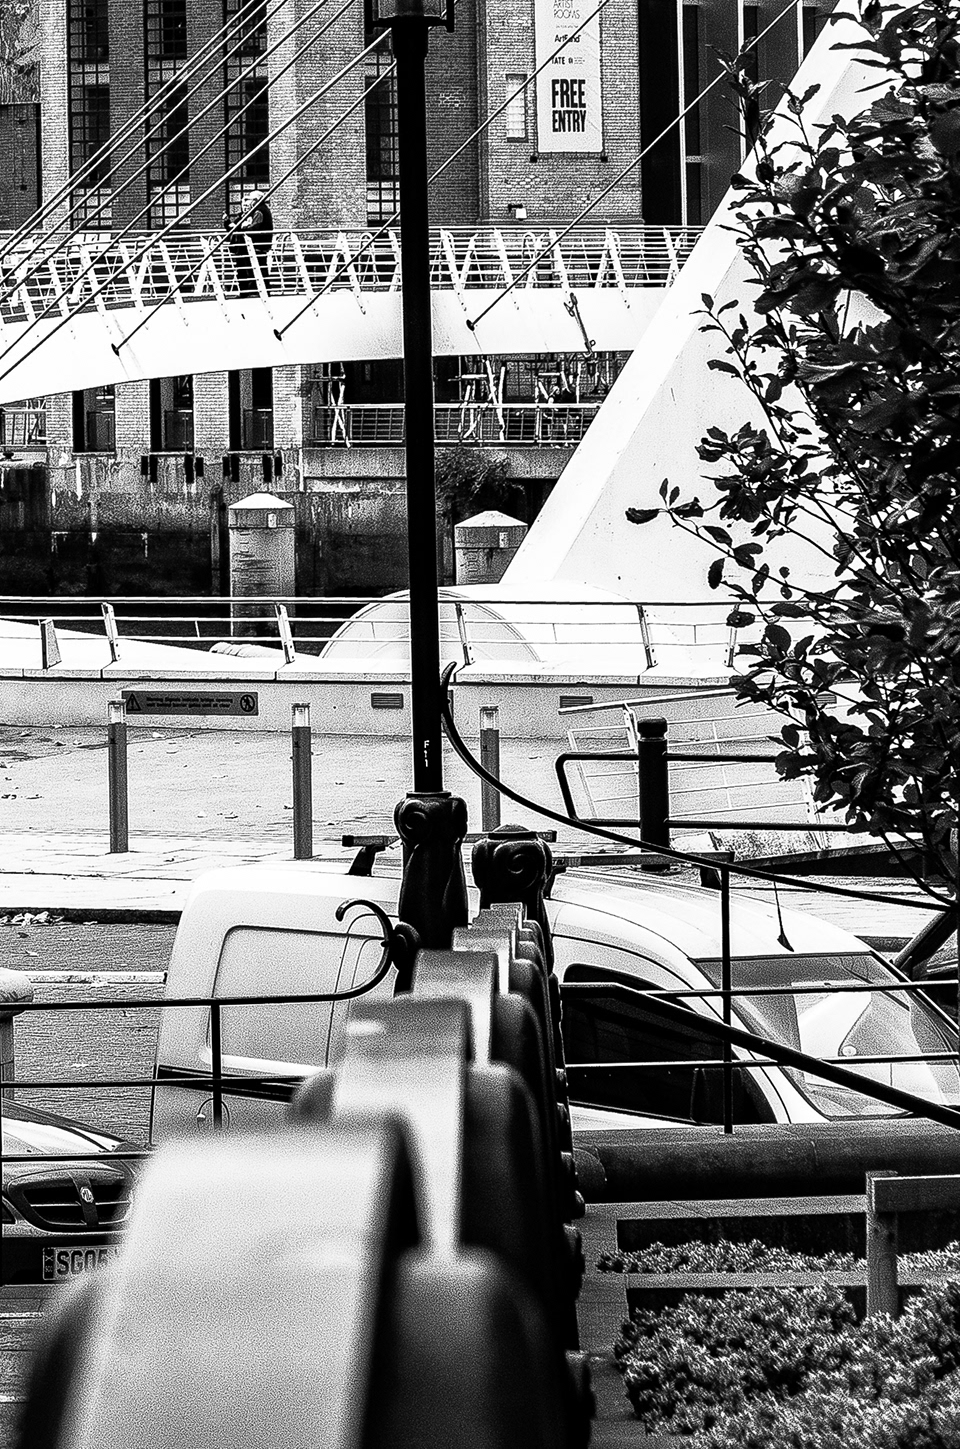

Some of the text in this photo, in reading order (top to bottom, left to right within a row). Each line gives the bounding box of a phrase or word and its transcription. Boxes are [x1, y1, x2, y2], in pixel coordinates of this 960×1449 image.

[554, 34, 582, 43] ArtFnd
[551, 78, 587, 108] FREE
[551, 109, 587, 133] ENTRY
